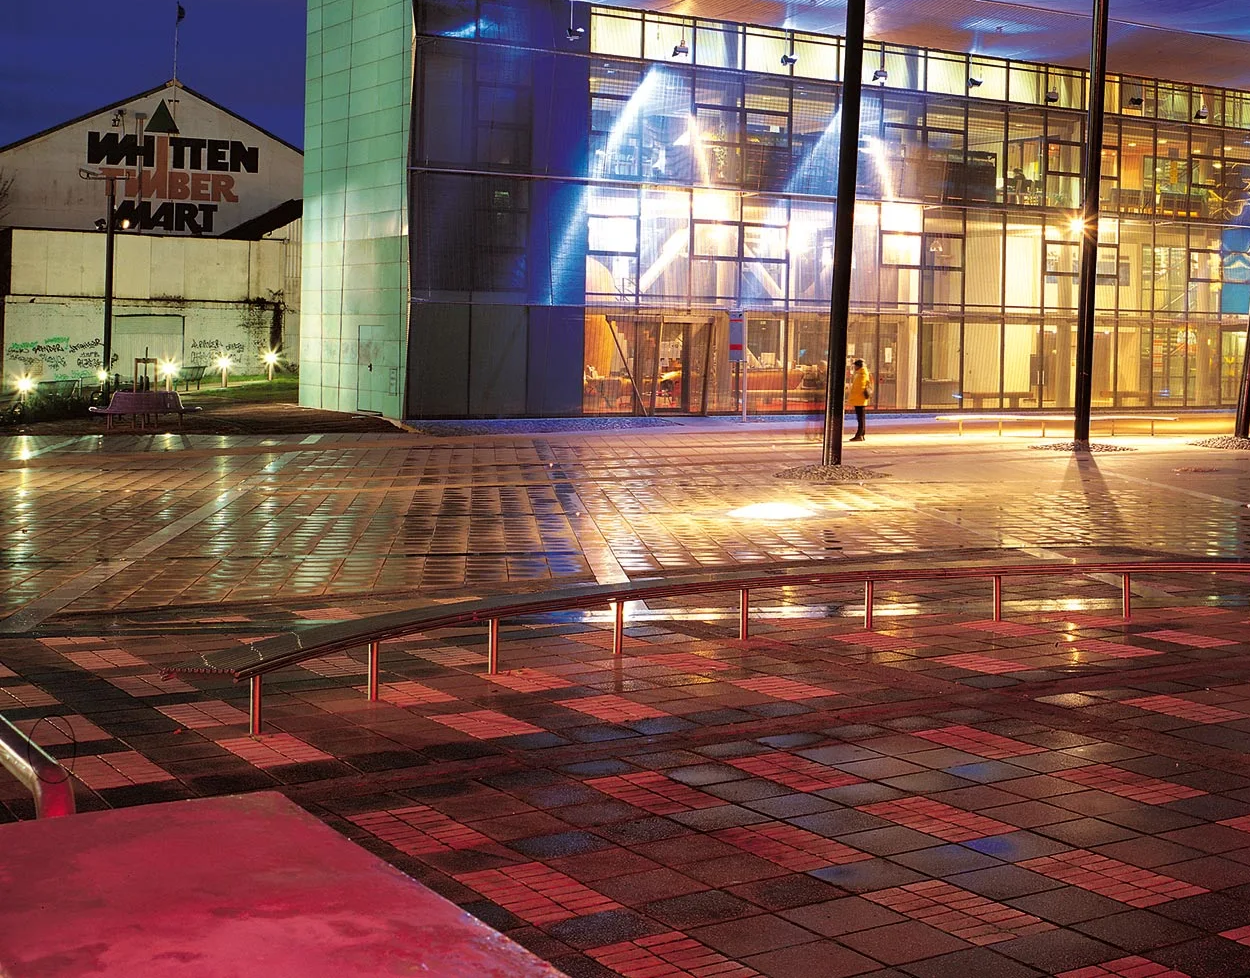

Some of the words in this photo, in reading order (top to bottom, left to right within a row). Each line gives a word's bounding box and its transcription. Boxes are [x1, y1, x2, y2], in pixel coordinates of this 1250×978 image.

[88, 131, 259, 174] WHITTEN
[99, 167, 239, 203] TIMBER
[114, 199, 218, 235] MART
